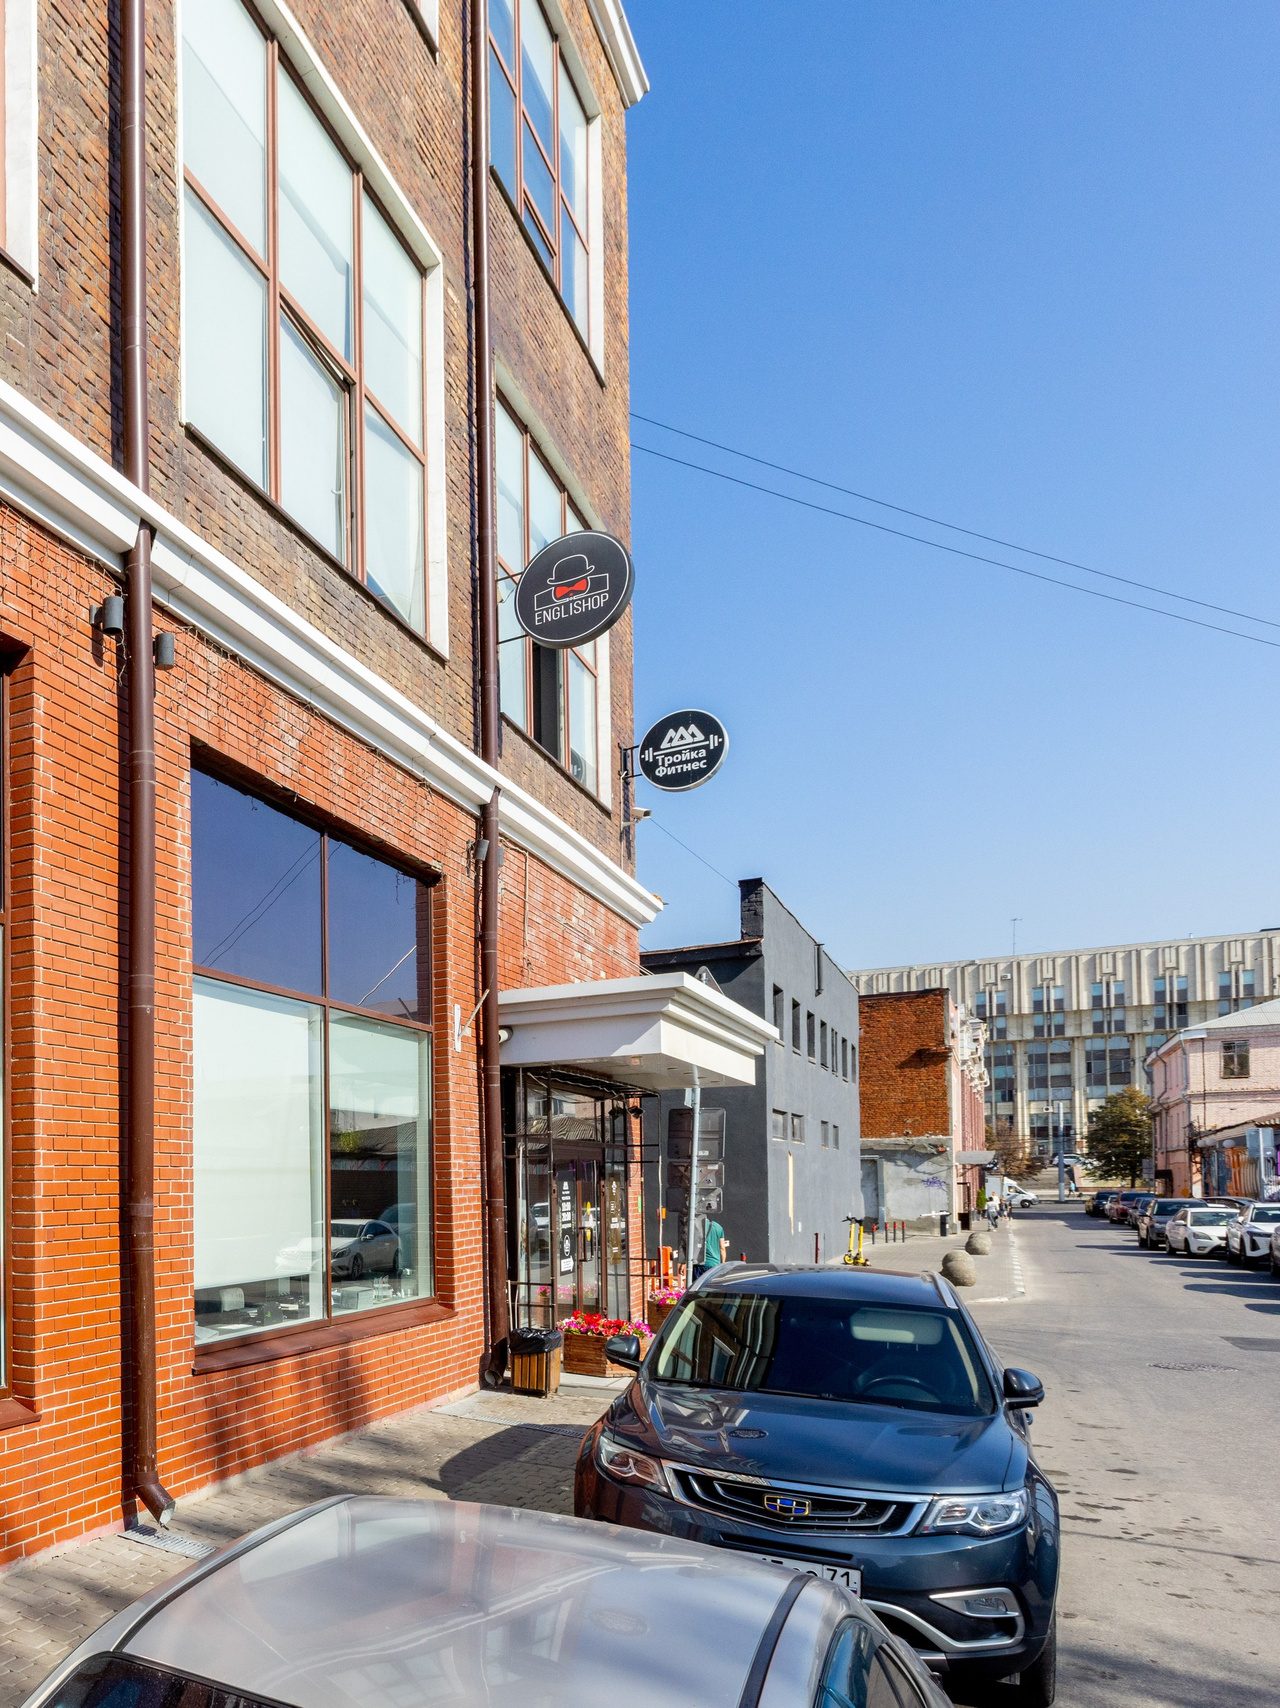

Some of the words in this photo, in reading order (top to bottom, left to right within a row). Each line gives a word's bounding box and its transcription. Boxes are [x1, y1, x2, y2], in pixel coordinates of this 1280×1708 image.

[535, 592, 609, 625] ENGLISHOP
[656, 748, 707, 767] Тройка
[655, 759, 707, 777] Фитнес
[826, 1567, 850, 1587] 71
